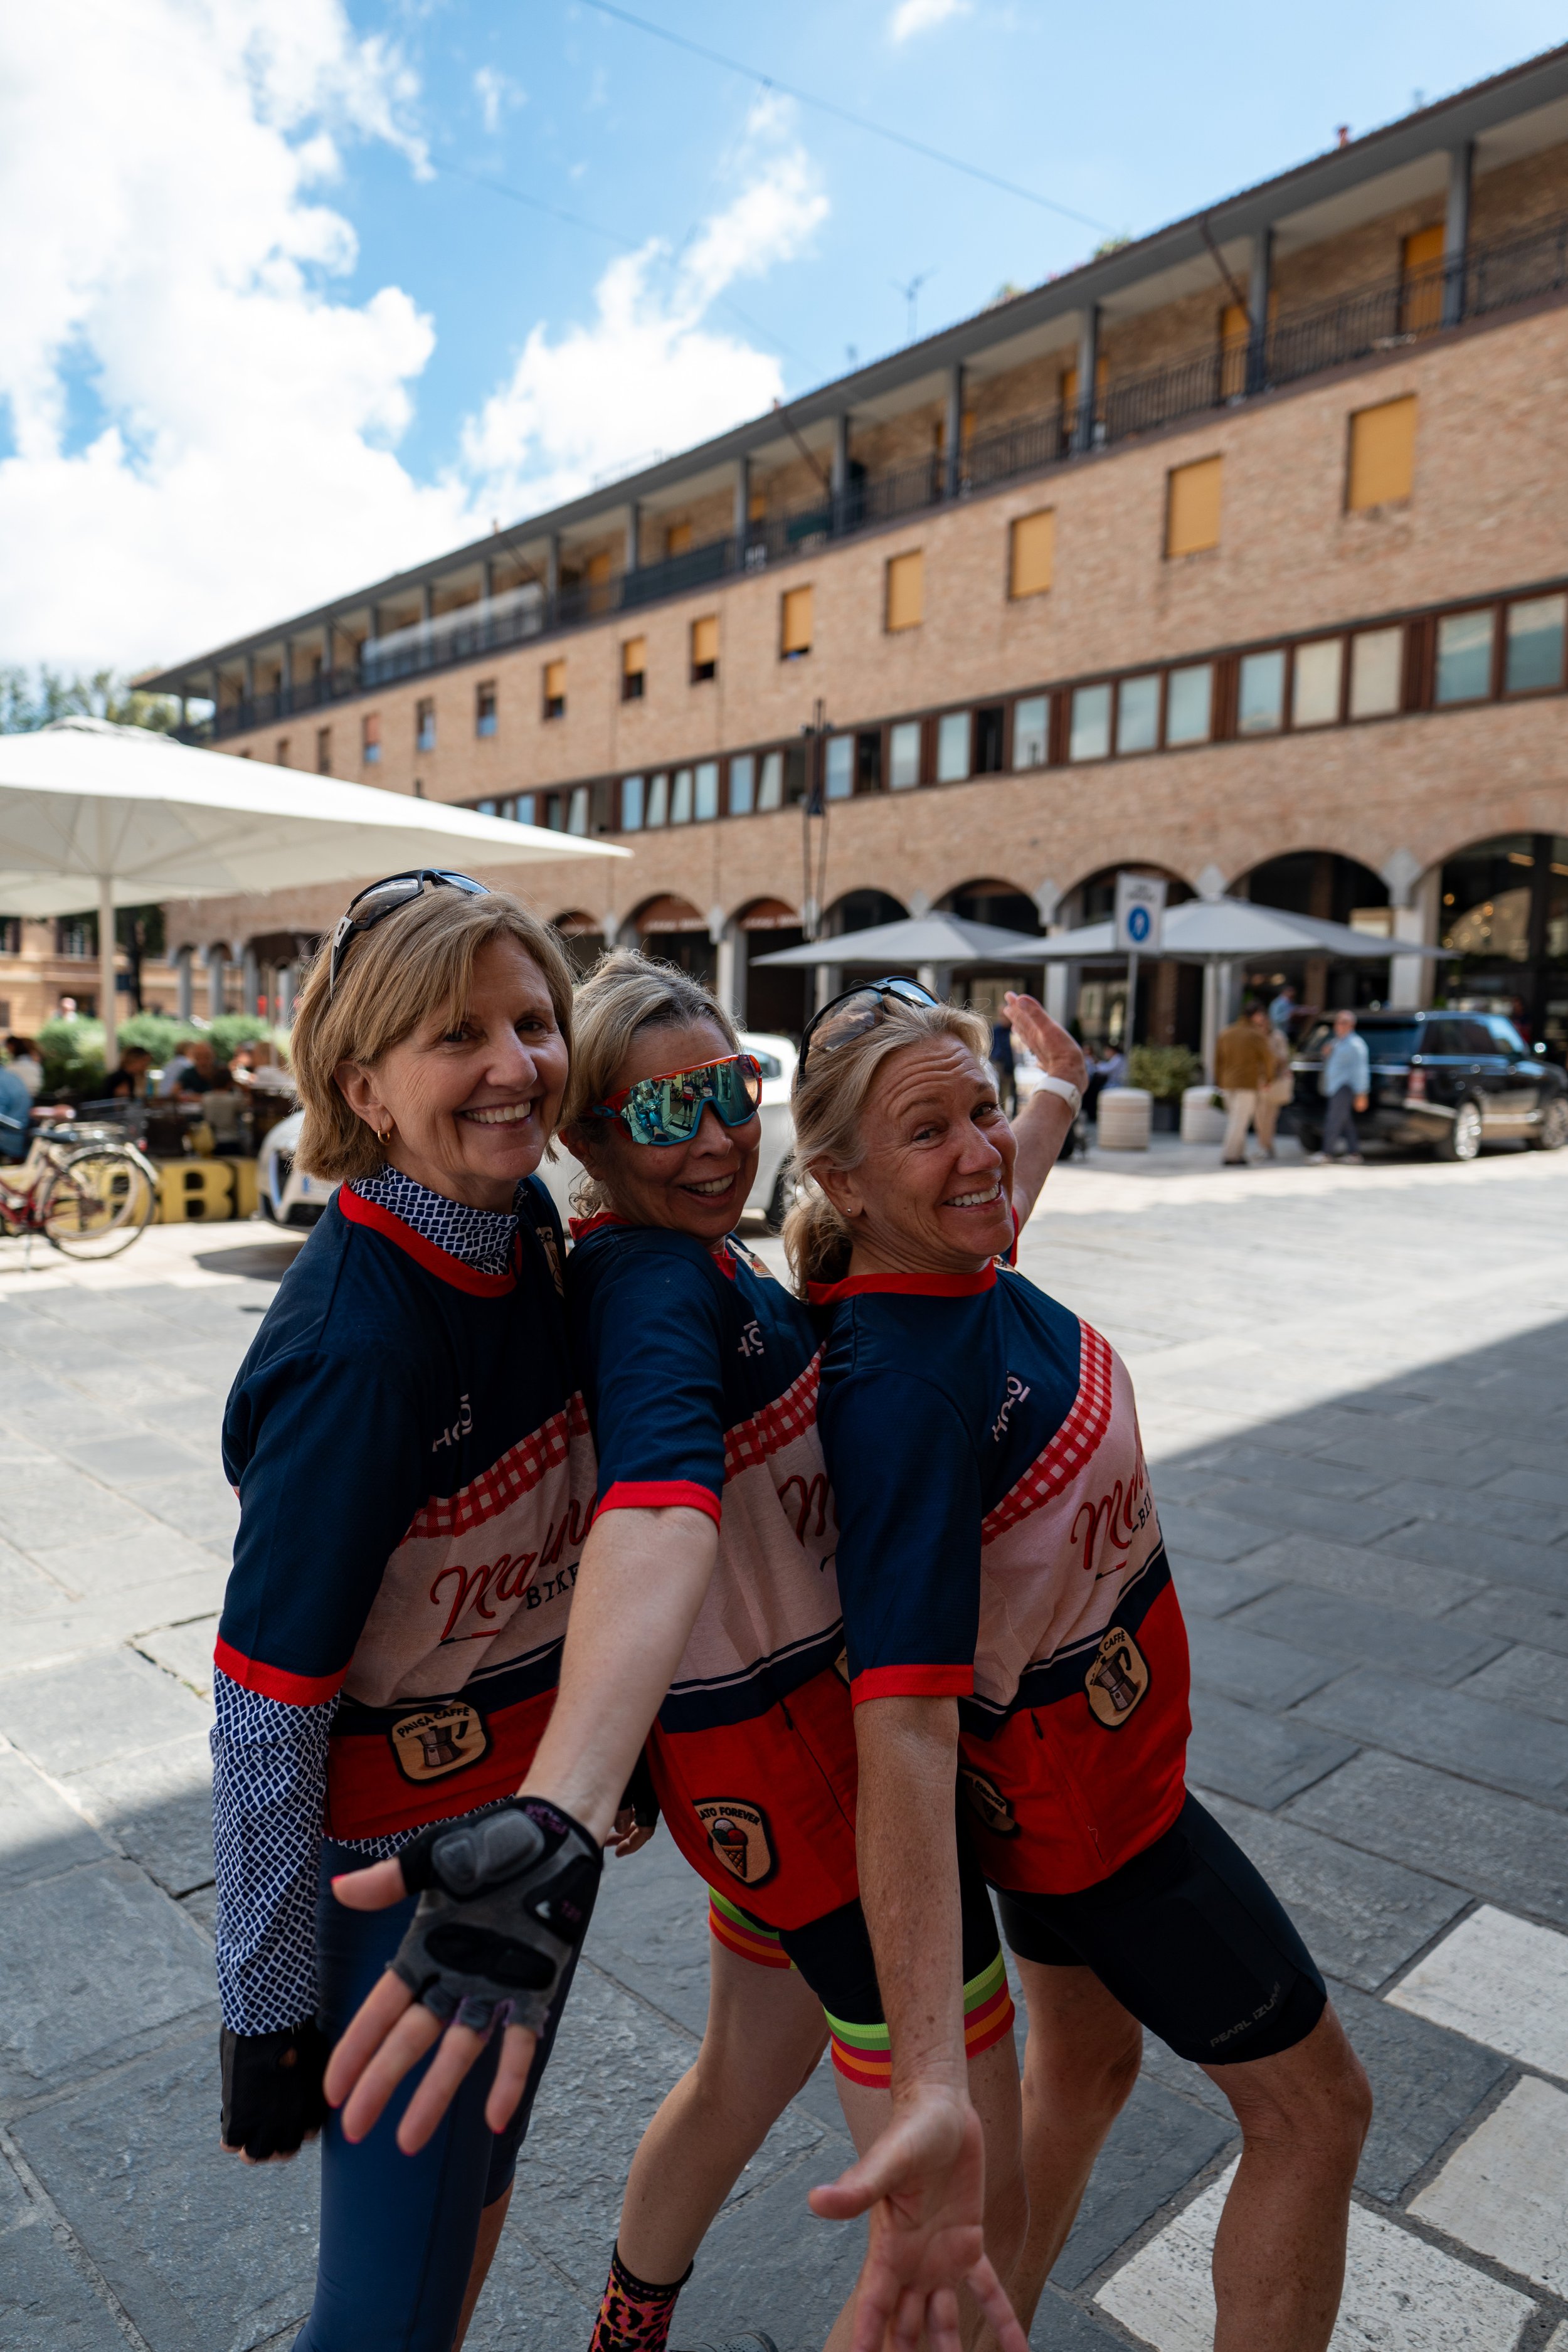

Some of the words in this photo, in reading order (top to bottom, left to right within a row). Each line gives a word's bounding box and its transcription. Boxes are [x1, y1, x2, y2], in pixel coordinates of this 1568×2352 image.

[396, 1715, 434, 1738] PAUSA
[433, 1706, 470, 1720] CAFFÈ
[719, 1806, 760, 1826] FOREVER
[1209, 2020, 1253, 2048] PEARL
